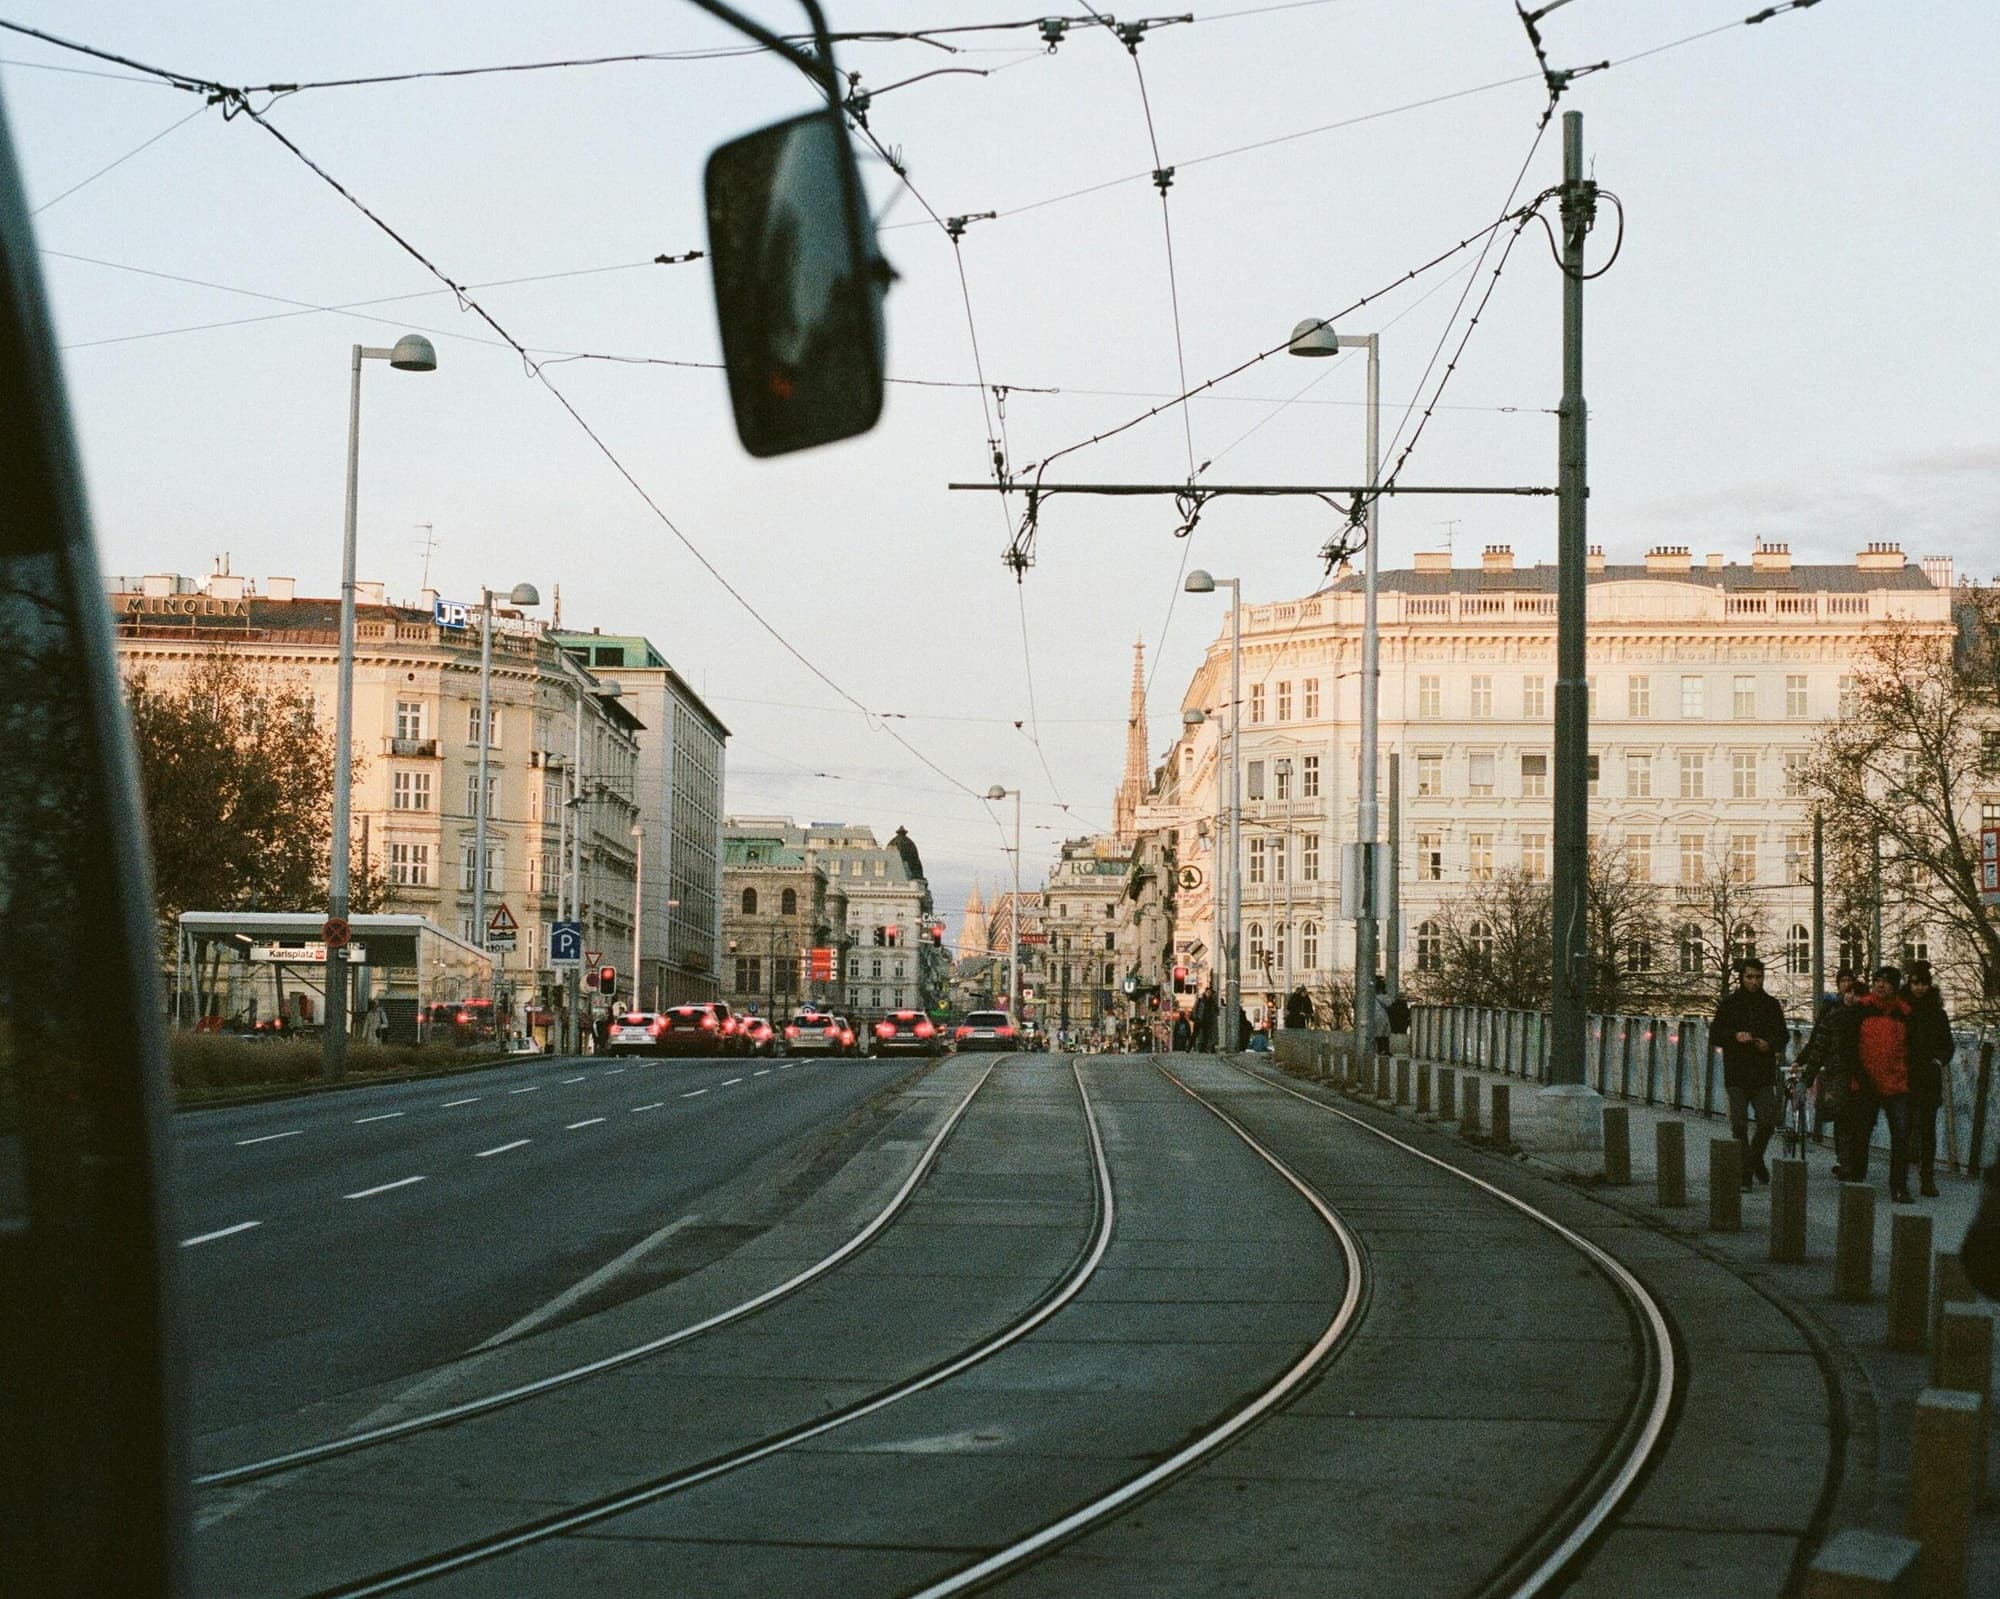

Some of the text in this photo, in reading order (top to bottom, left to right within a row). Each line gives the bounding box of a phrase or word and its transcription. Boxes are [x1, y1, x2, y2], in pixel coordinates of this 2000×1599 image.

[125, 598, 249, 617] MINOLTA
[438, 604, 465, 624] JP
[560, 934, 573, 953] P
[269, 950, 314, 959] Karlsplatz
[1124, 982, 1135, 993] U
